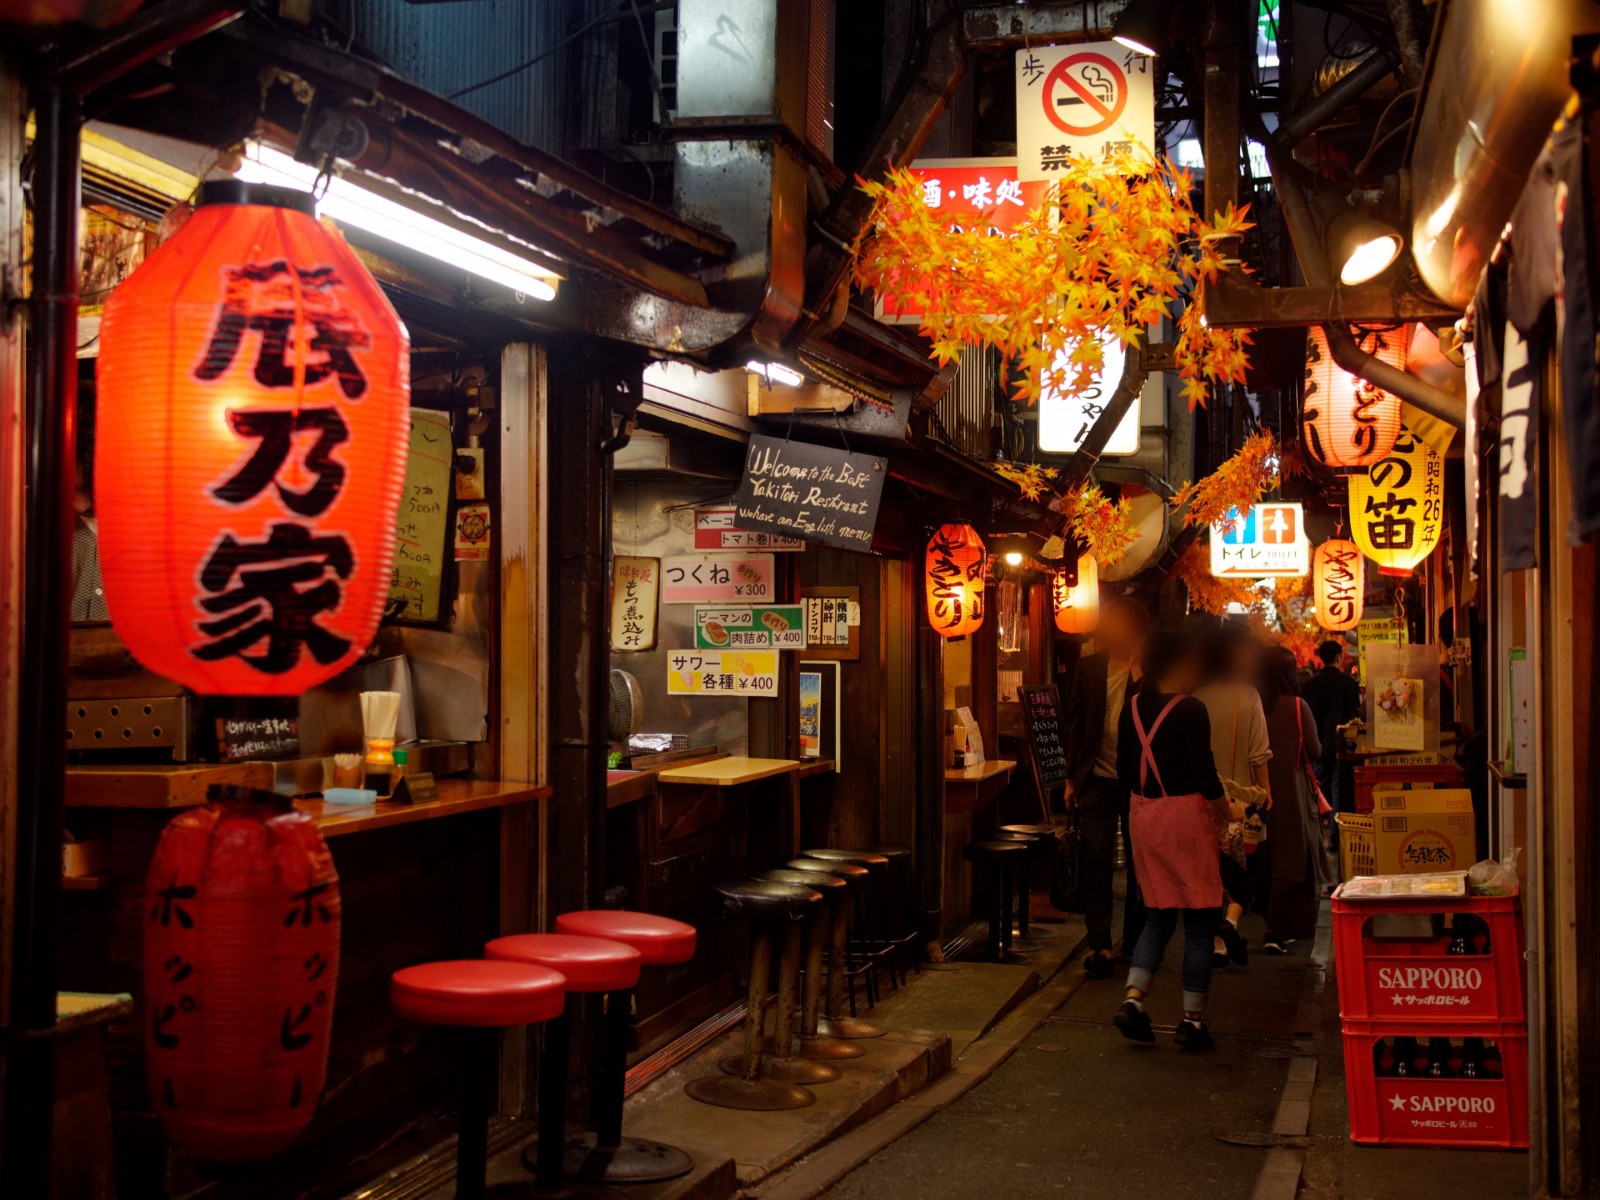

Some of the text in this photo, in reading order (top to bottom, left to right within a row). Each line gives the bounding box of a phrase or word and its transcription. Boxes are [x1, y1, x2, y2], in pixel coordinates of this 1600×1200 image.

[1023, 51, 1149, 86] 歩 行
[748, 445, 870, 488] Welcome to the Best
[722, 534, 768, 545] トマト巻
[1222, 547, 1261, 560] トイレ
[666, 564, 730, 584] つくね
[734, 584, 766, 595] ¥300
[622, 579, 645, 646] もつ煮込み
[763, 612, 788, 631] 手作り
[811, 602, 819, 633] ナンコツ
[823, 602, 834, 623] 砂肝
[732, 632, 800, 645] 肉詰め ¥400
[672, 656, 721, 671] サワー
[702, 673, 773, 690] 各種 ¥400
[1379, 967, 1482, 989] SAPPORO
[1404, 995, 1470, 1005] サッポロビール
[1410, 1095, 1496, 1113] SAPPORO
[1411, 1119, 1457, 1128] サッポロビール
